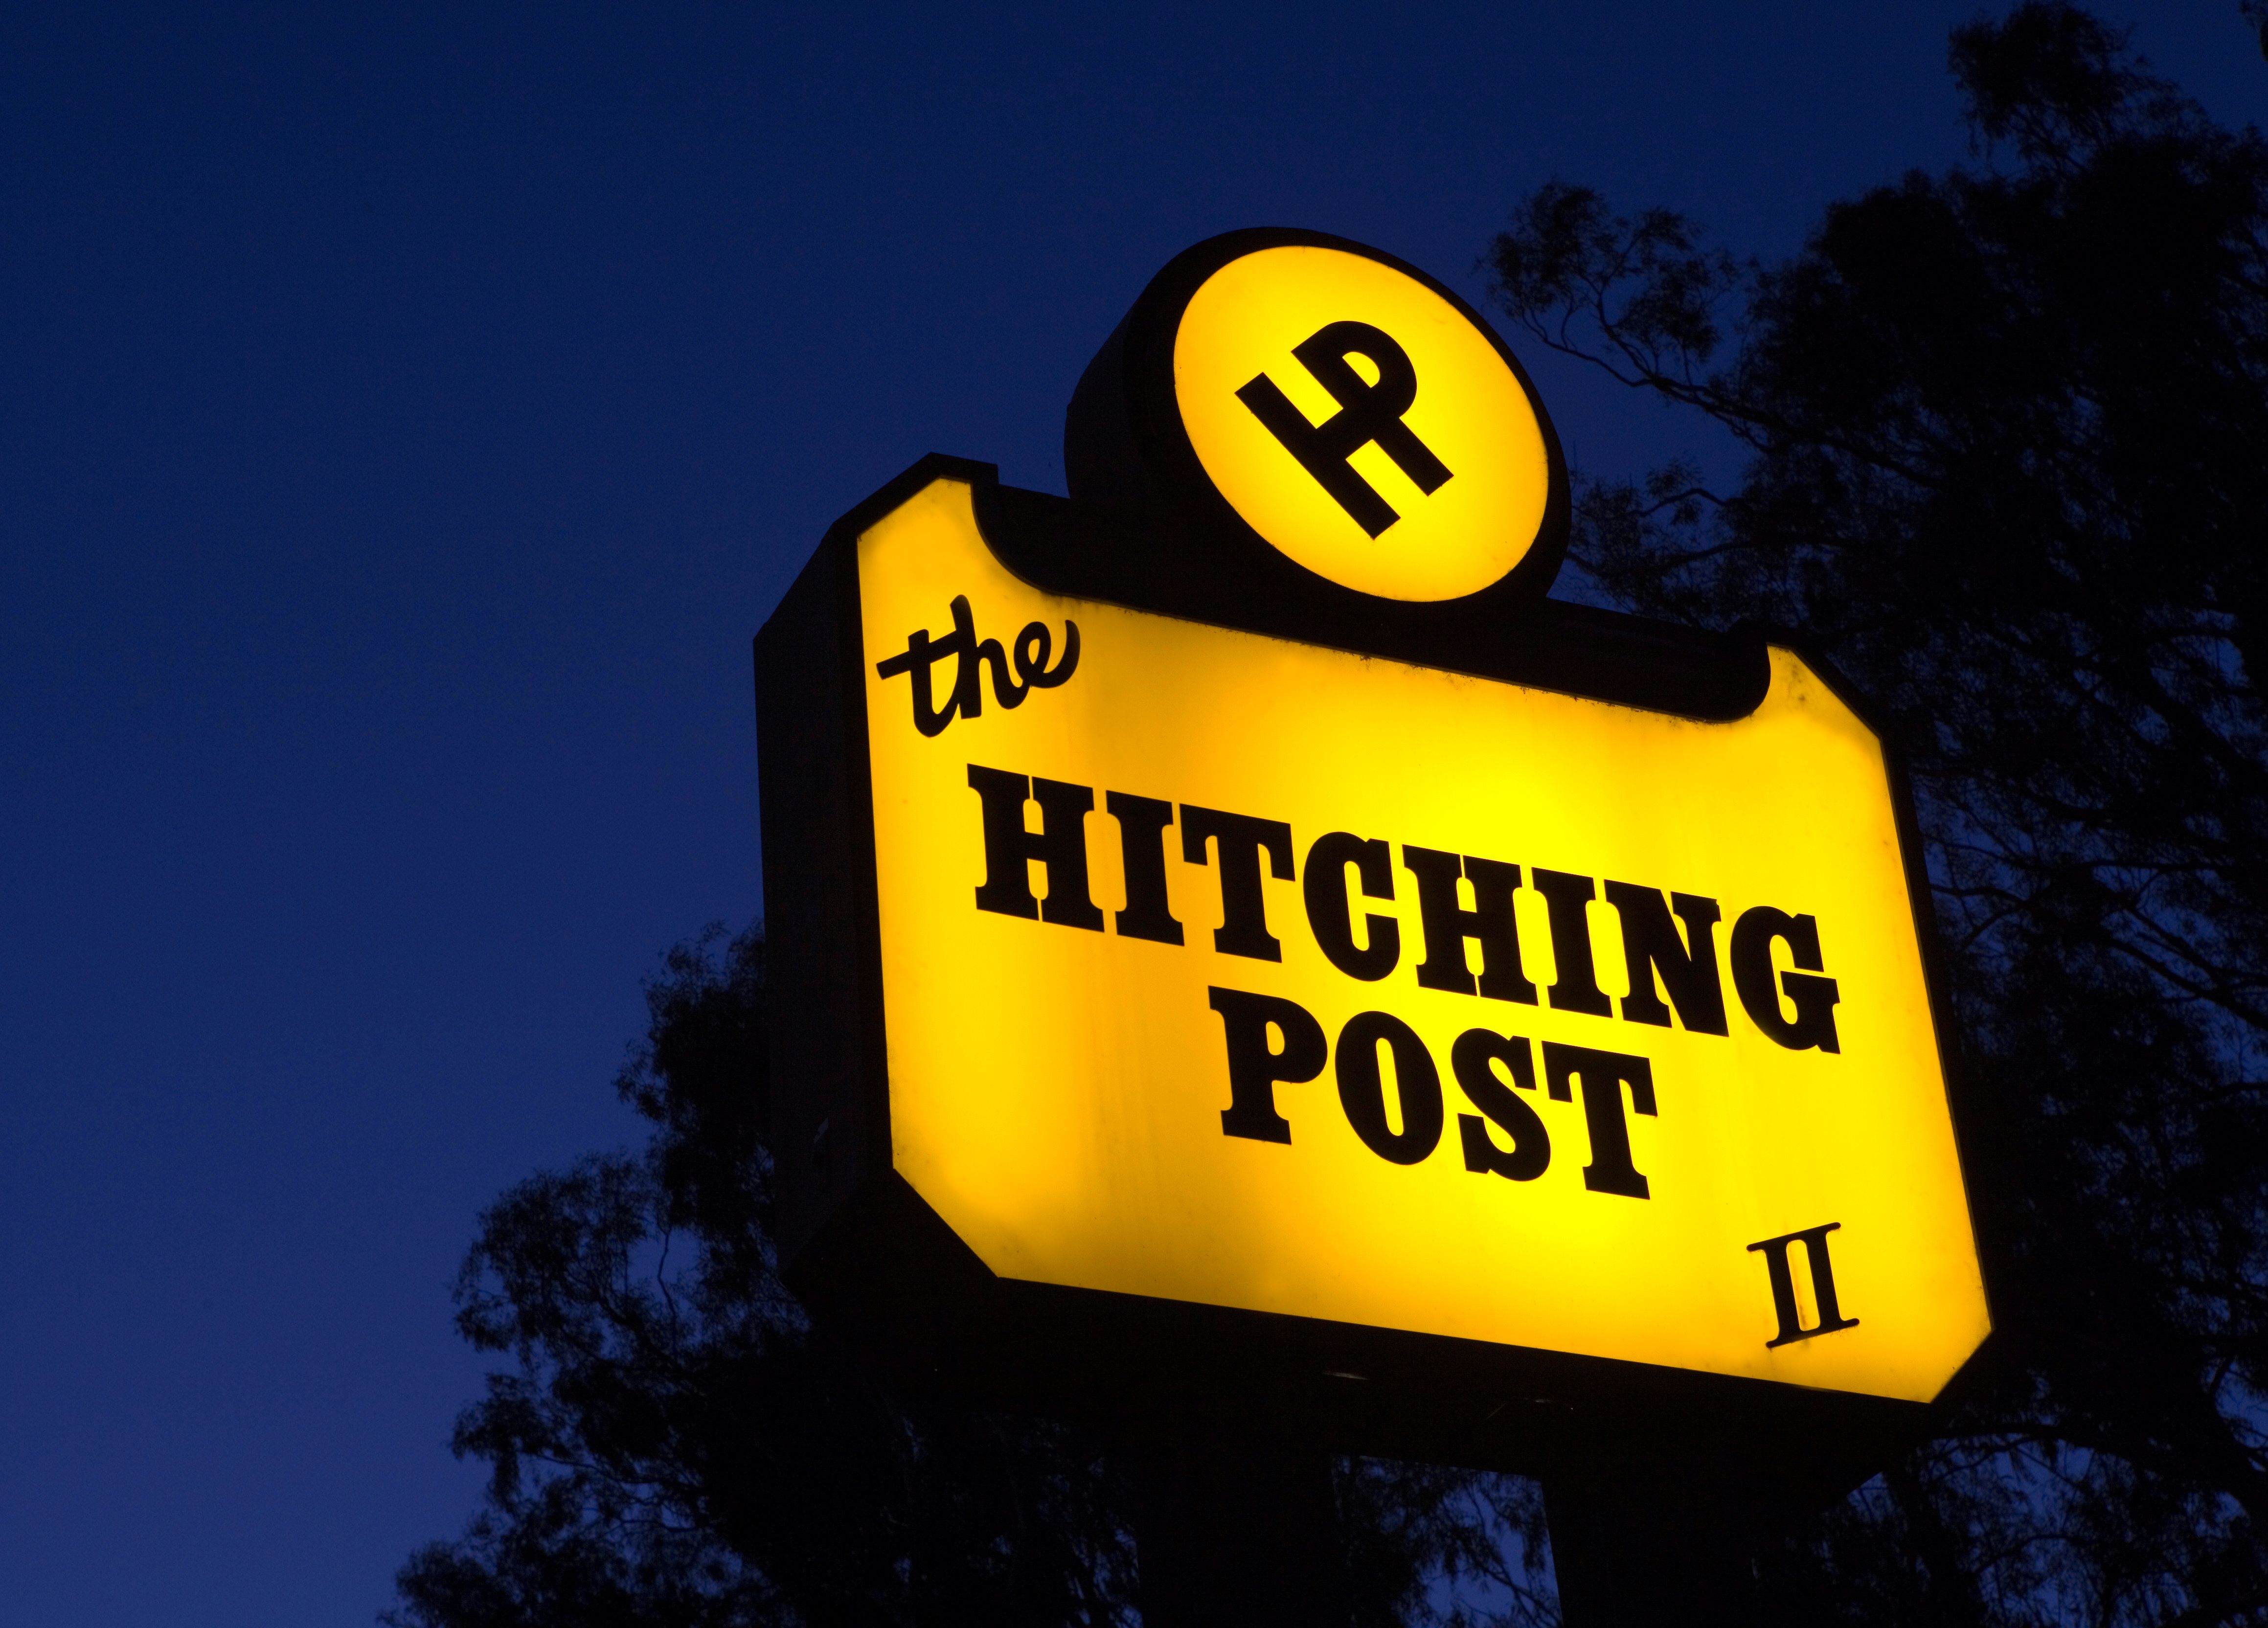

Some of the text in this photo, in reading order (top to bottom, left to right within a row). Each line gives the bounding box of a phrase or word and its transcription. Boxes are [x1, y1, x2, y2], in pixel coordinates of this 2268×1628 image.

[877, 595, 1080, 737] the
[968, 764, 1840, 1053] HITCHING
[1208, 986, 1657, 1198] POST
[1747, 1222, 1859, 1348] II
